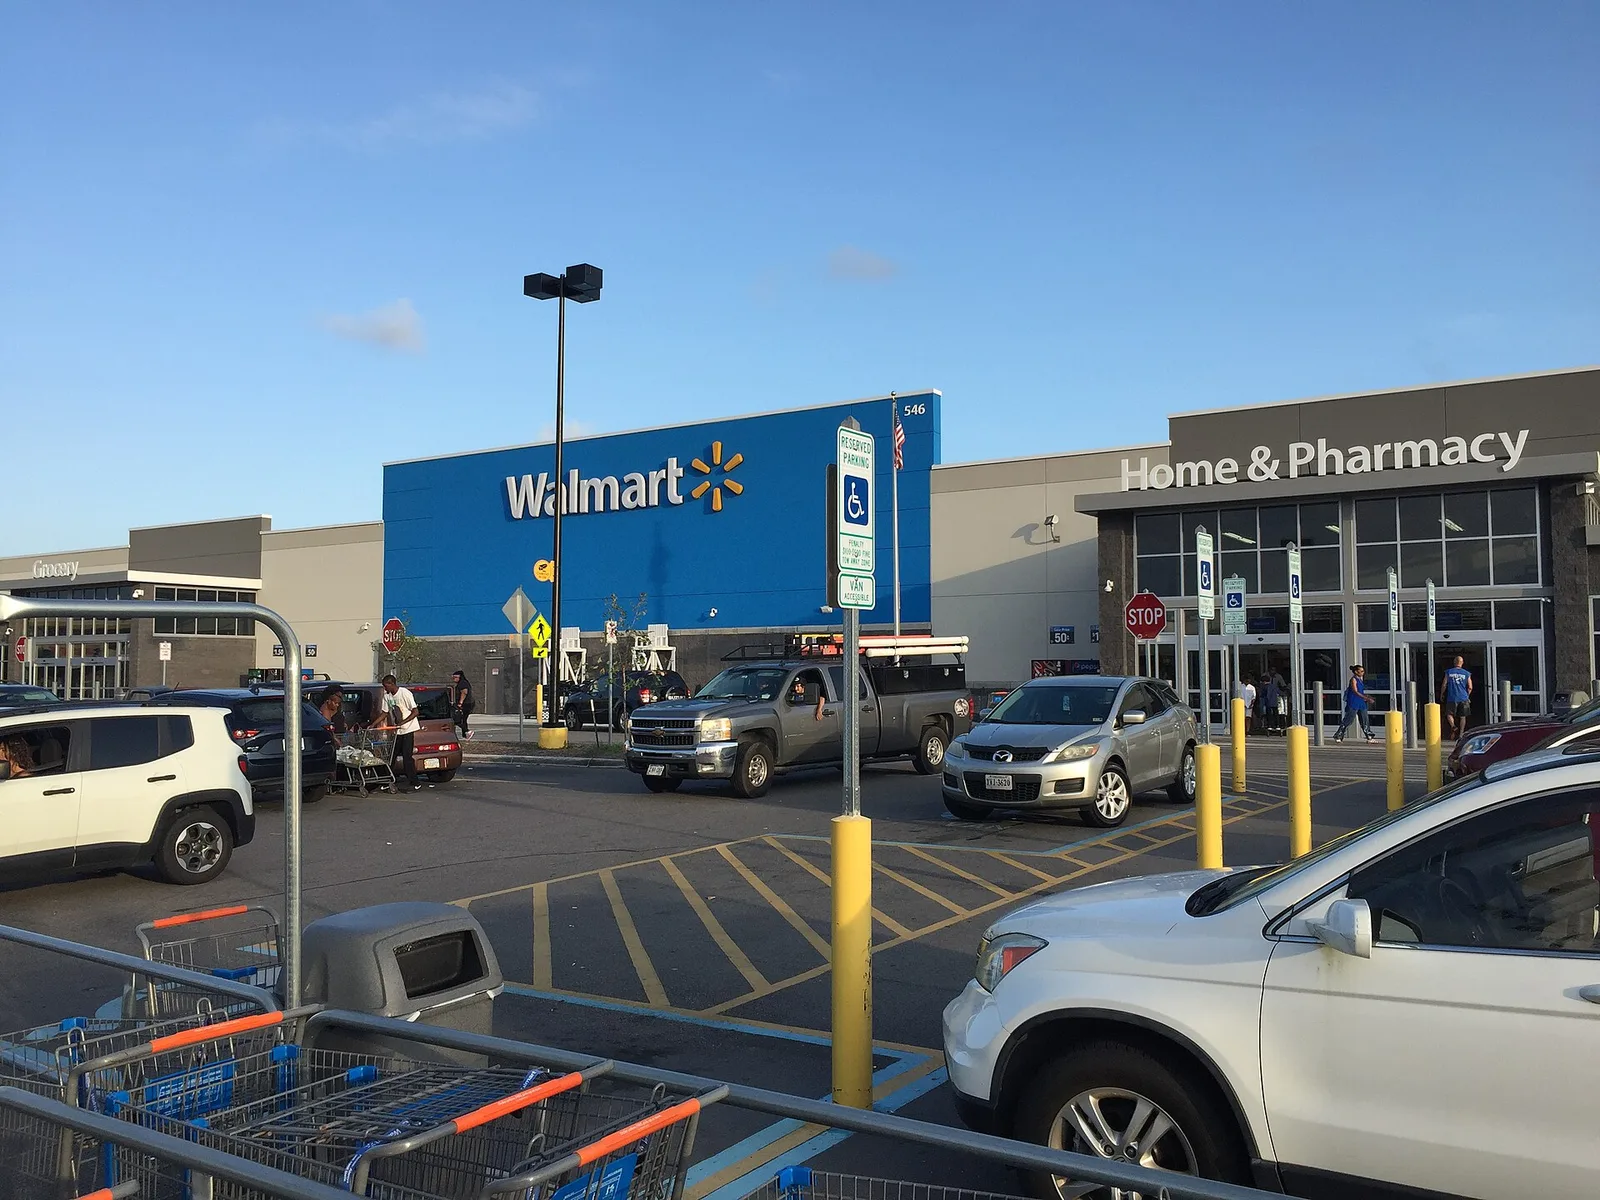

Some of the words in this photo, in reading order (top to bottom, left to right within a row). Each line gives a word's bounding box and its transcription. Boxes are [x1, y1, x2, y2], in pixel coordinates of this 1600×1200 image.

[904, 403, 926, 417] 546
[841, 436, 872, 454] RESERVED
[843, 452, 870, 469] PARKING
[1120, 458, 1240, 491] Home
[1246, 446, 1281, 481] &
[1288, 429, 1531, 478] Pharmacy
[505, 456, 684, 520] Walmart
[33, 560, 79, 582] Grocery
[849, 581, 864, 592] VAN
[844, 593, 870, 602] ACCESSIBLE
[1128, 607, 1163, 626] STOP
